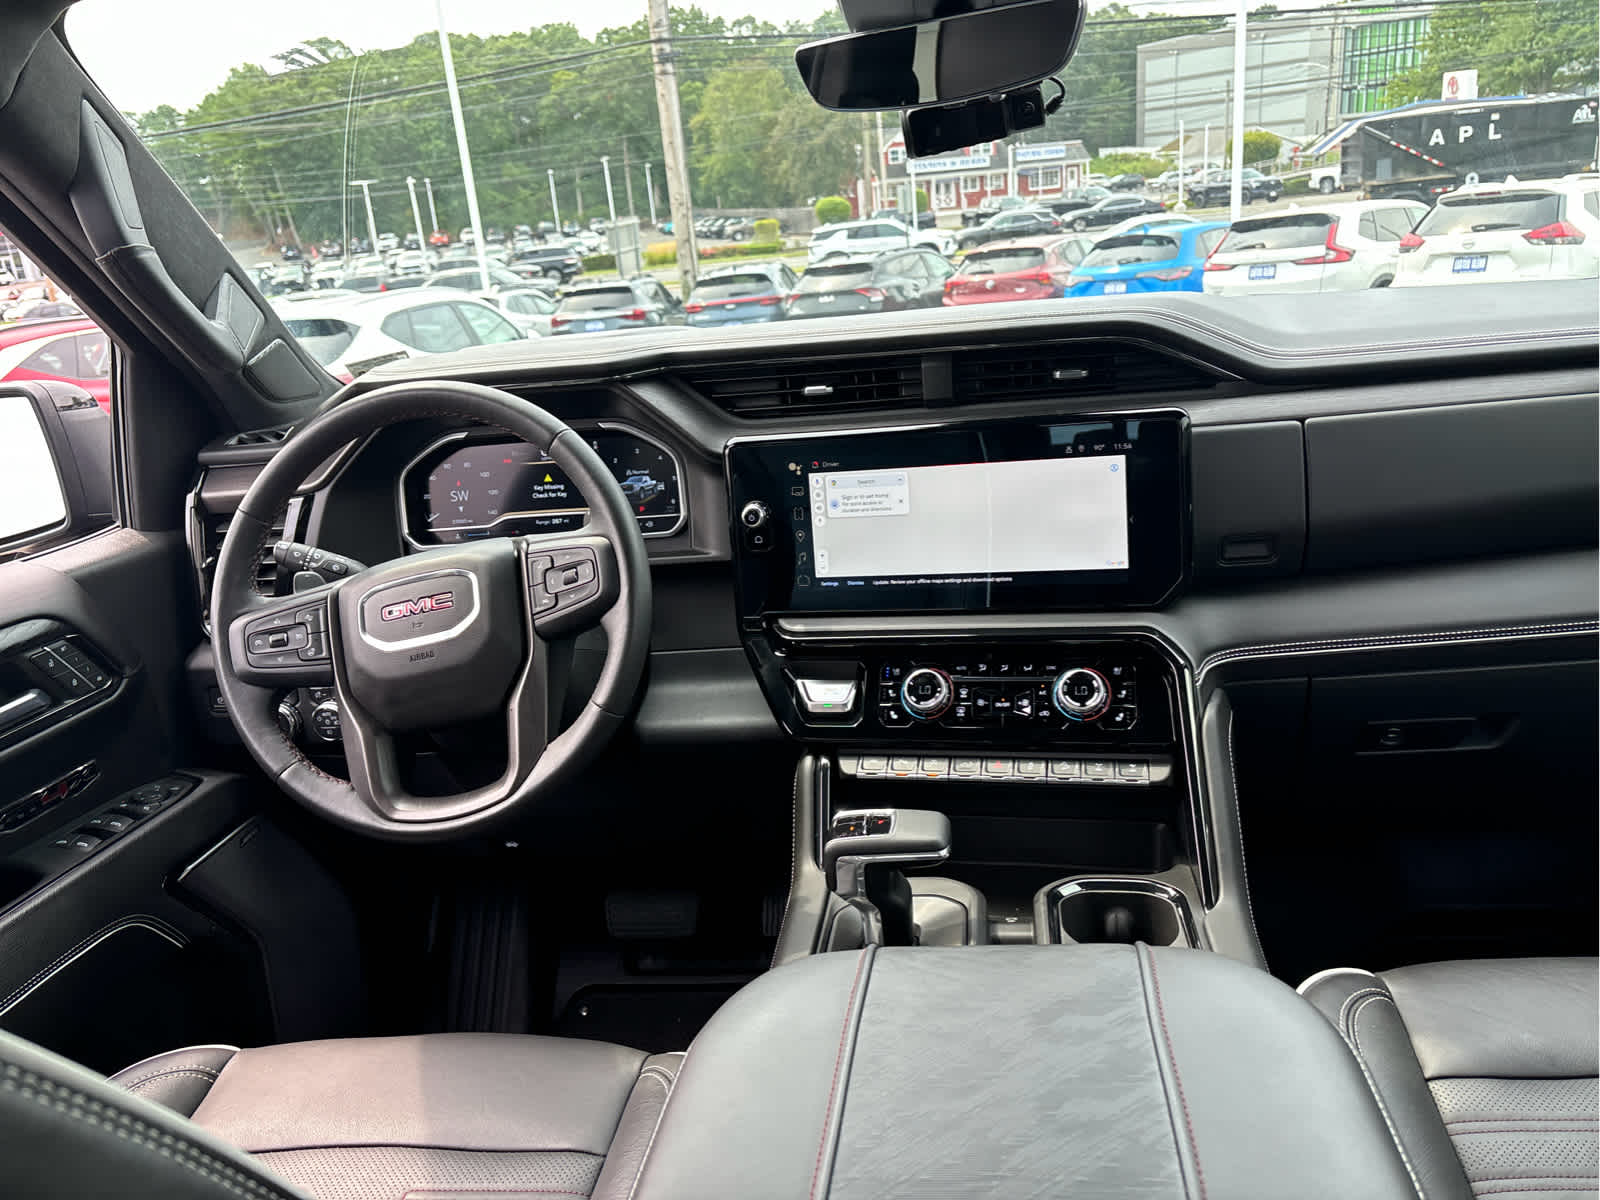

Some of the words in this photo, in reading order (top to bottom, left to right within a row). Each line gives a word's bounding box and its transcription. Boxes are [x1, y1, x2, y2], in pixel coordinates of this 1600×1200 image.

[1113, 442, 1133, 450] 11:54
[533, 484, 544, 492] Key
[543, 483, 565, 491] Missing
[449, 489, 470, 503] SW
[381, 591, 454, 622] GMC
[408, 650, 435, 663] AIRBAG
[1074, 685, 1089, 696] LO
